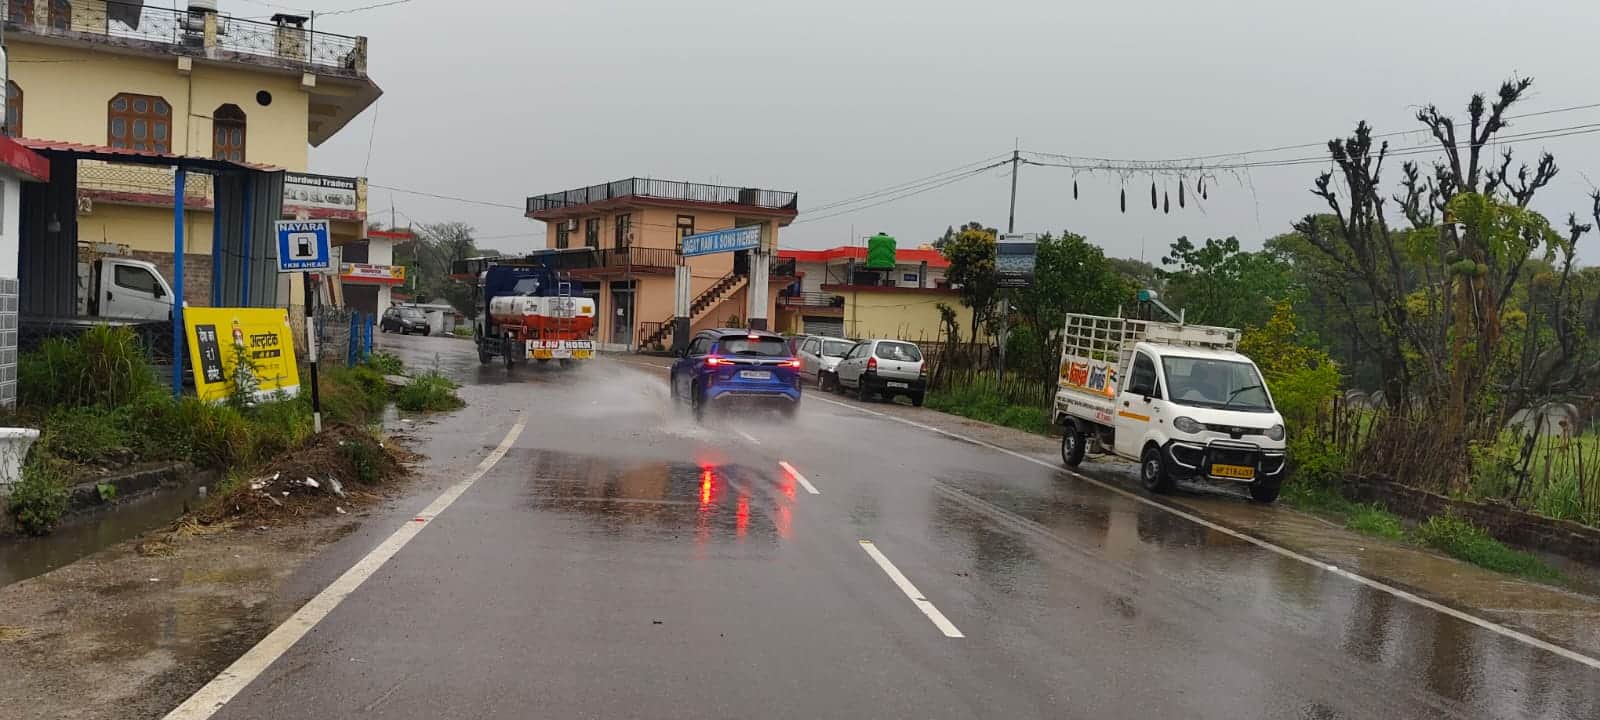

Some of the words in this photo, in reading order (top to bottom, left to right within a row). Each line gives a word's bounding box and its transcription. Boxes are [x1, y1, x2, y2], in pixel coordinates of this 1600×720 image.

[285, 174, 321, 186] hardwaj
[322, 178, 354, 189] Traders
[280, 222, 325, 231] NAYARA
[682, 239, 700, 254] JAGAT
[719, 231, 736, 249] SONS
[532, 340, 559, 349] BLOW
[565, 341, 592, 350] HORN
